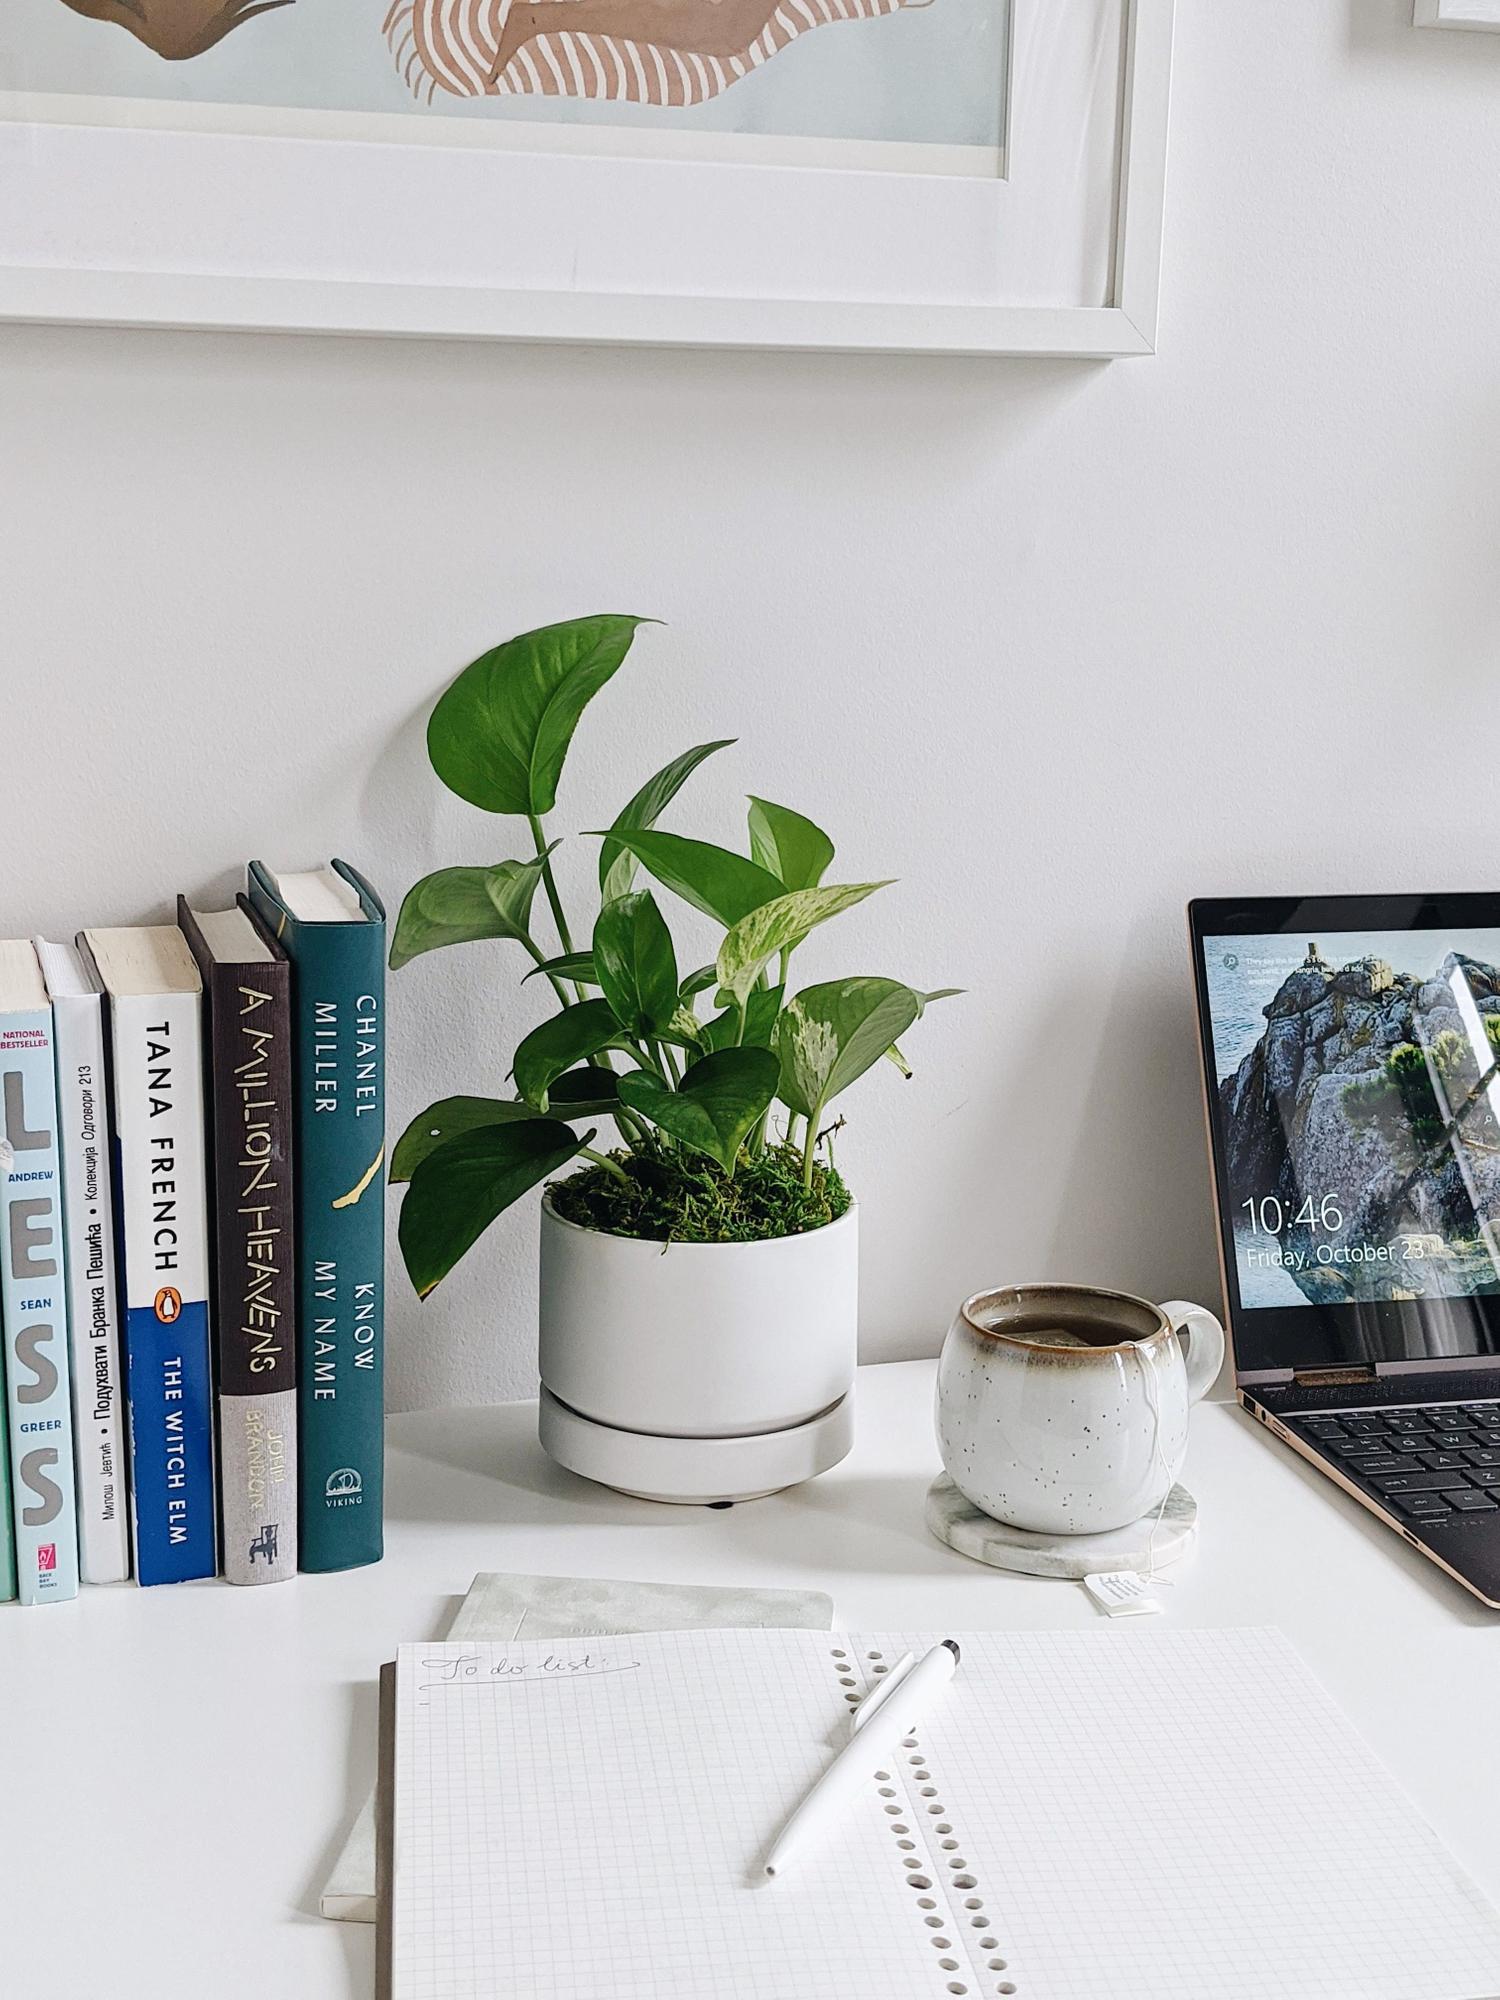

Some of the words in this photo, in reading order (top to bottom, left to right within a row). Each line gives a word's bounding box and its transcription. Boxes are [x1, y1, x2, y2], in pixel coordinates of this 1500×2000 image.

[238, 986, 273, 1015] A
[0, 1039, 48, 1049] BESTSELLER
[3, 1030, 45, 1039] NATIONAL
[315, 1002, 337, 1113] MILLER
[356, 995, 377, 1117] CHANEL
[79, 1065, 91, 1084] 213
[146, 1021, 173, 1118] TANA
[81, 1089, 96, 1140] Одговори
[234, 1027, 278, 1197] MILLION
[8, 1171, 54, 1183] ANDREW
[82, 1146, 98, 1200] Колекција
[150, 1138, 178, 1270] FRENCH
[1241, 1193, 1343, 1235] 10:46
[85, 1223, 103, 1279] Пешића
[1247, 1247, 1311, 1271] Friday,
[1316, 1242, 1395, 1265] October
[1401, 1240, 1425, 1260] 23
[20, 1298, 52, 1310] SEAN
[238, 1206, 283, 1373] HEAVENS
[314, 1261, 337, 1301] MY
[90, 1287, 110, 1338] Бранка
[354, 1283, 375, 1370] KNOW
[93, 1345, 113, 1420] Подухвати
[163, 1356, 182, 1400] THE
[314, 1317, 336, 1400] NAME
[20, 1420, 62, 1432] GREER
[165, 1410, 186, 1489] WITCH
[246, 1409, 266, 1512] BRANDON
[102, 1484, 115, 1520] Милош
[168, 1500, 187, 1545] ELM
[326, 1496, 362, 1508] VIKING
[421, 1655, 482, 1680] To
[490, 1658, 528, 1675] do
